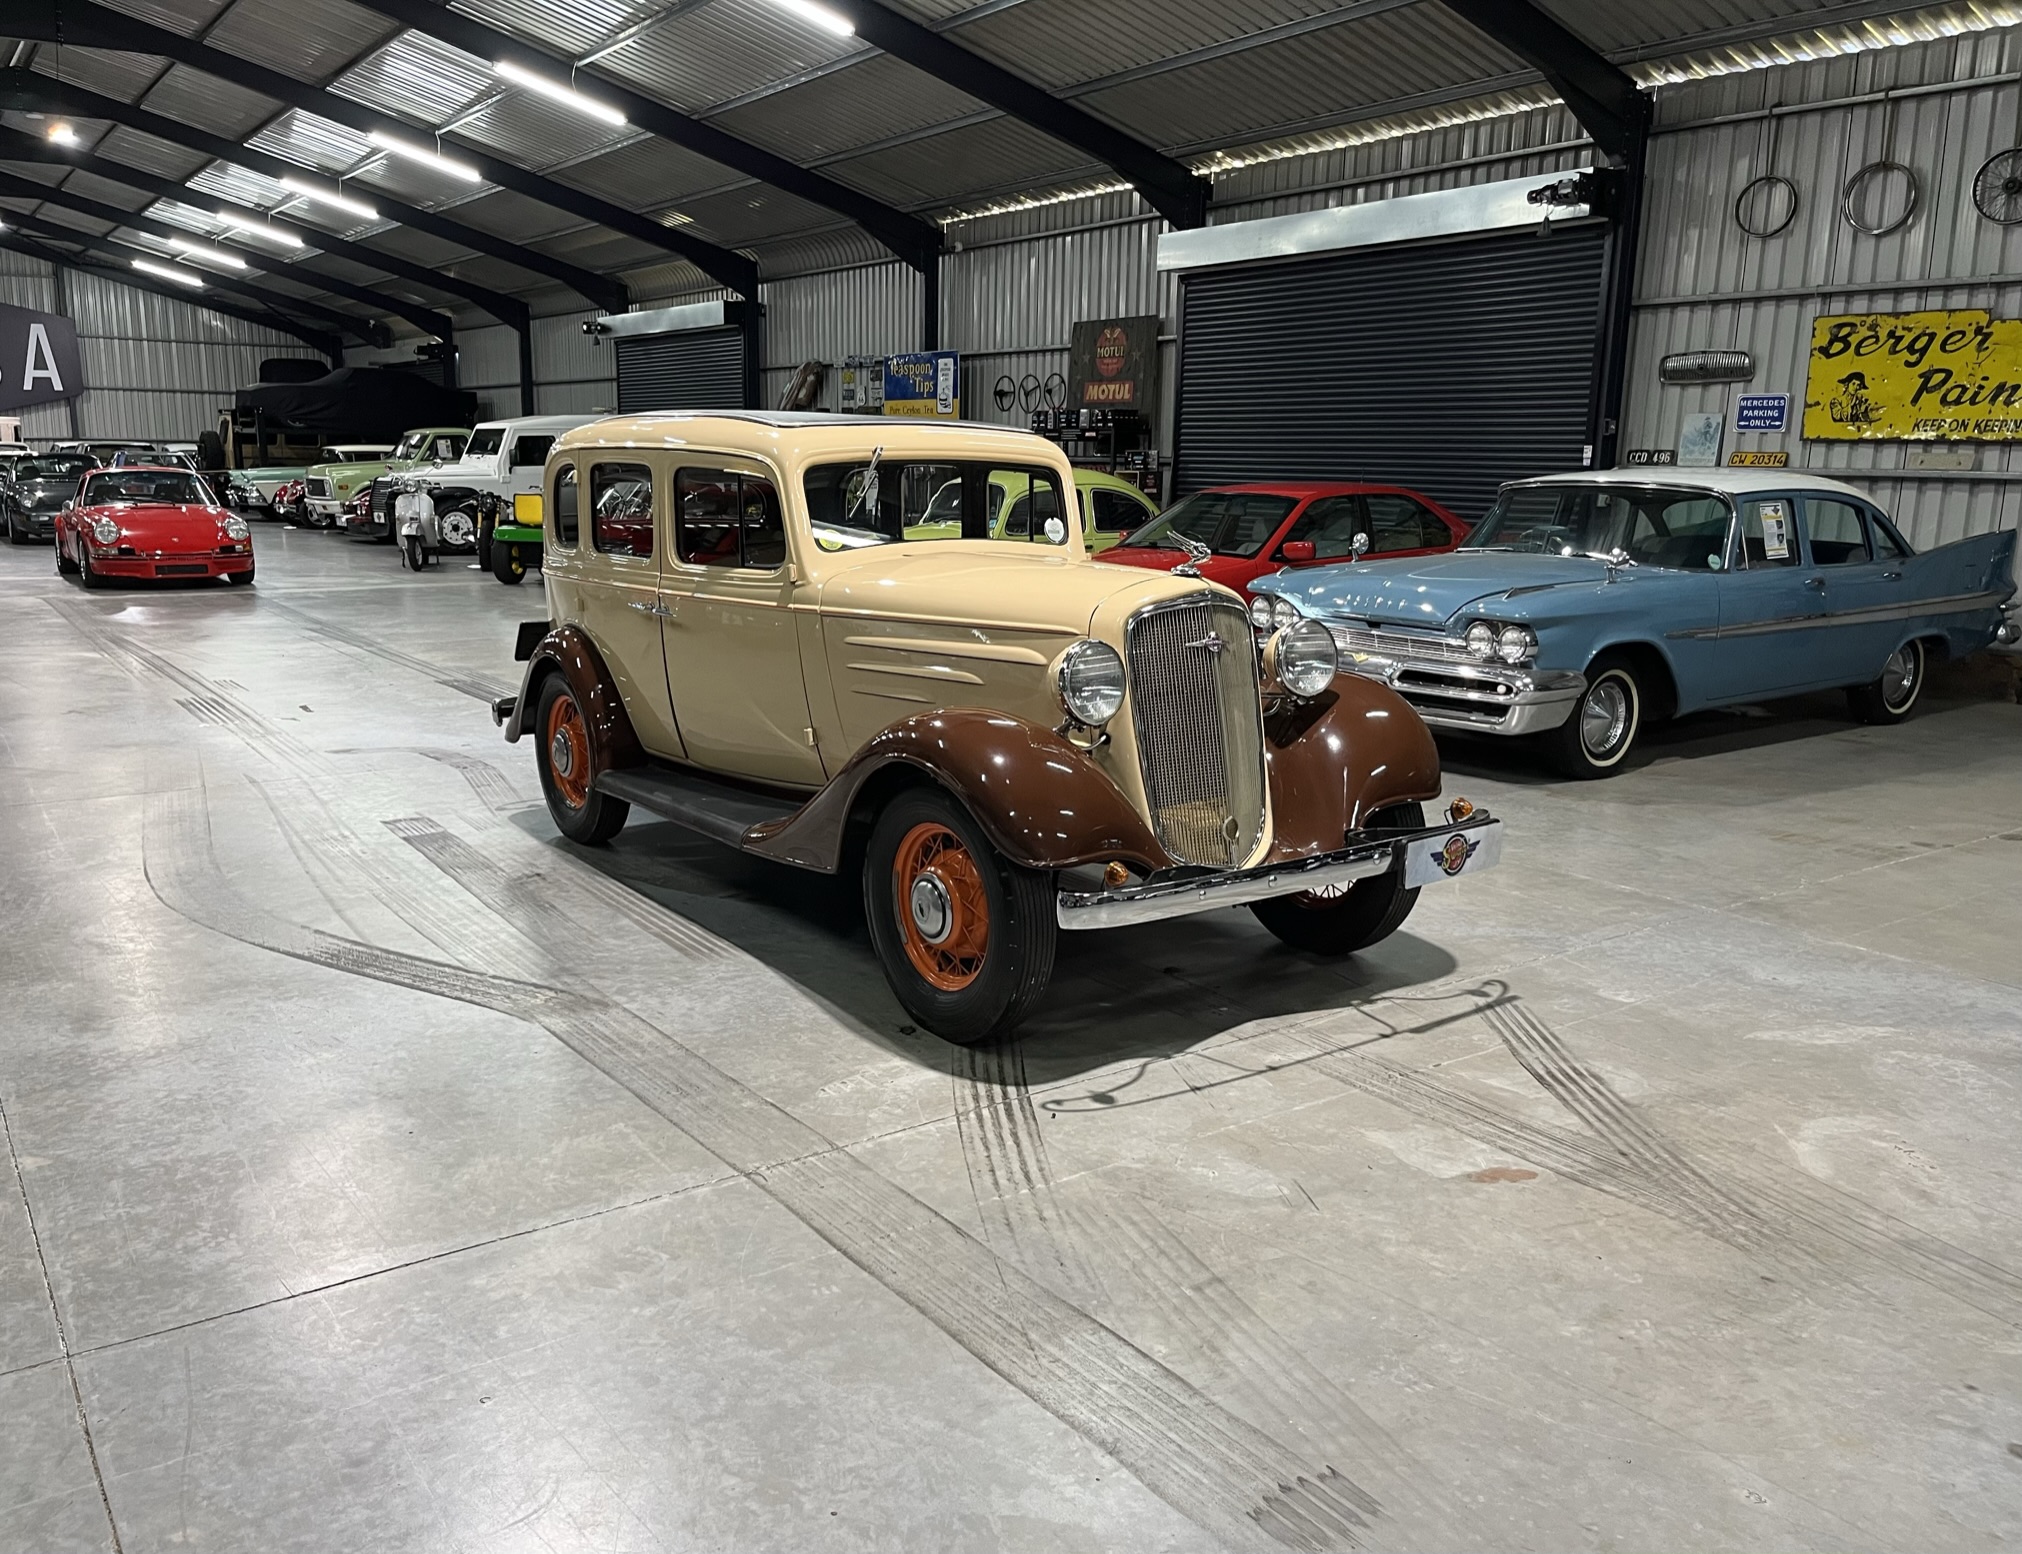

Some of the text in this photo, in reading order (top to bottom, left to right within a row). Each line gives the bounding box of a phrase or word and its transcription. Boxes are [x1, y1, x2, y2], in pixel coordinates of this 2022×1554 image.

[1818, 322, 1994, 368] Berger
[889, 359, 931, 379] Teaspoon
[915, 377, 934, 397] Tips
[1086, 384, 1131, 400] MOTUL
[1910, 368, 2022, 407] Pain
[1912, 418, 1947, 432] KEEP
[1949, 418, 1970, 432] ON
[1629, 452, 1648, 463] CCD
[1652, 452, 1671, 463] 496
[1730, 454, 1784, 465] CW 20314
